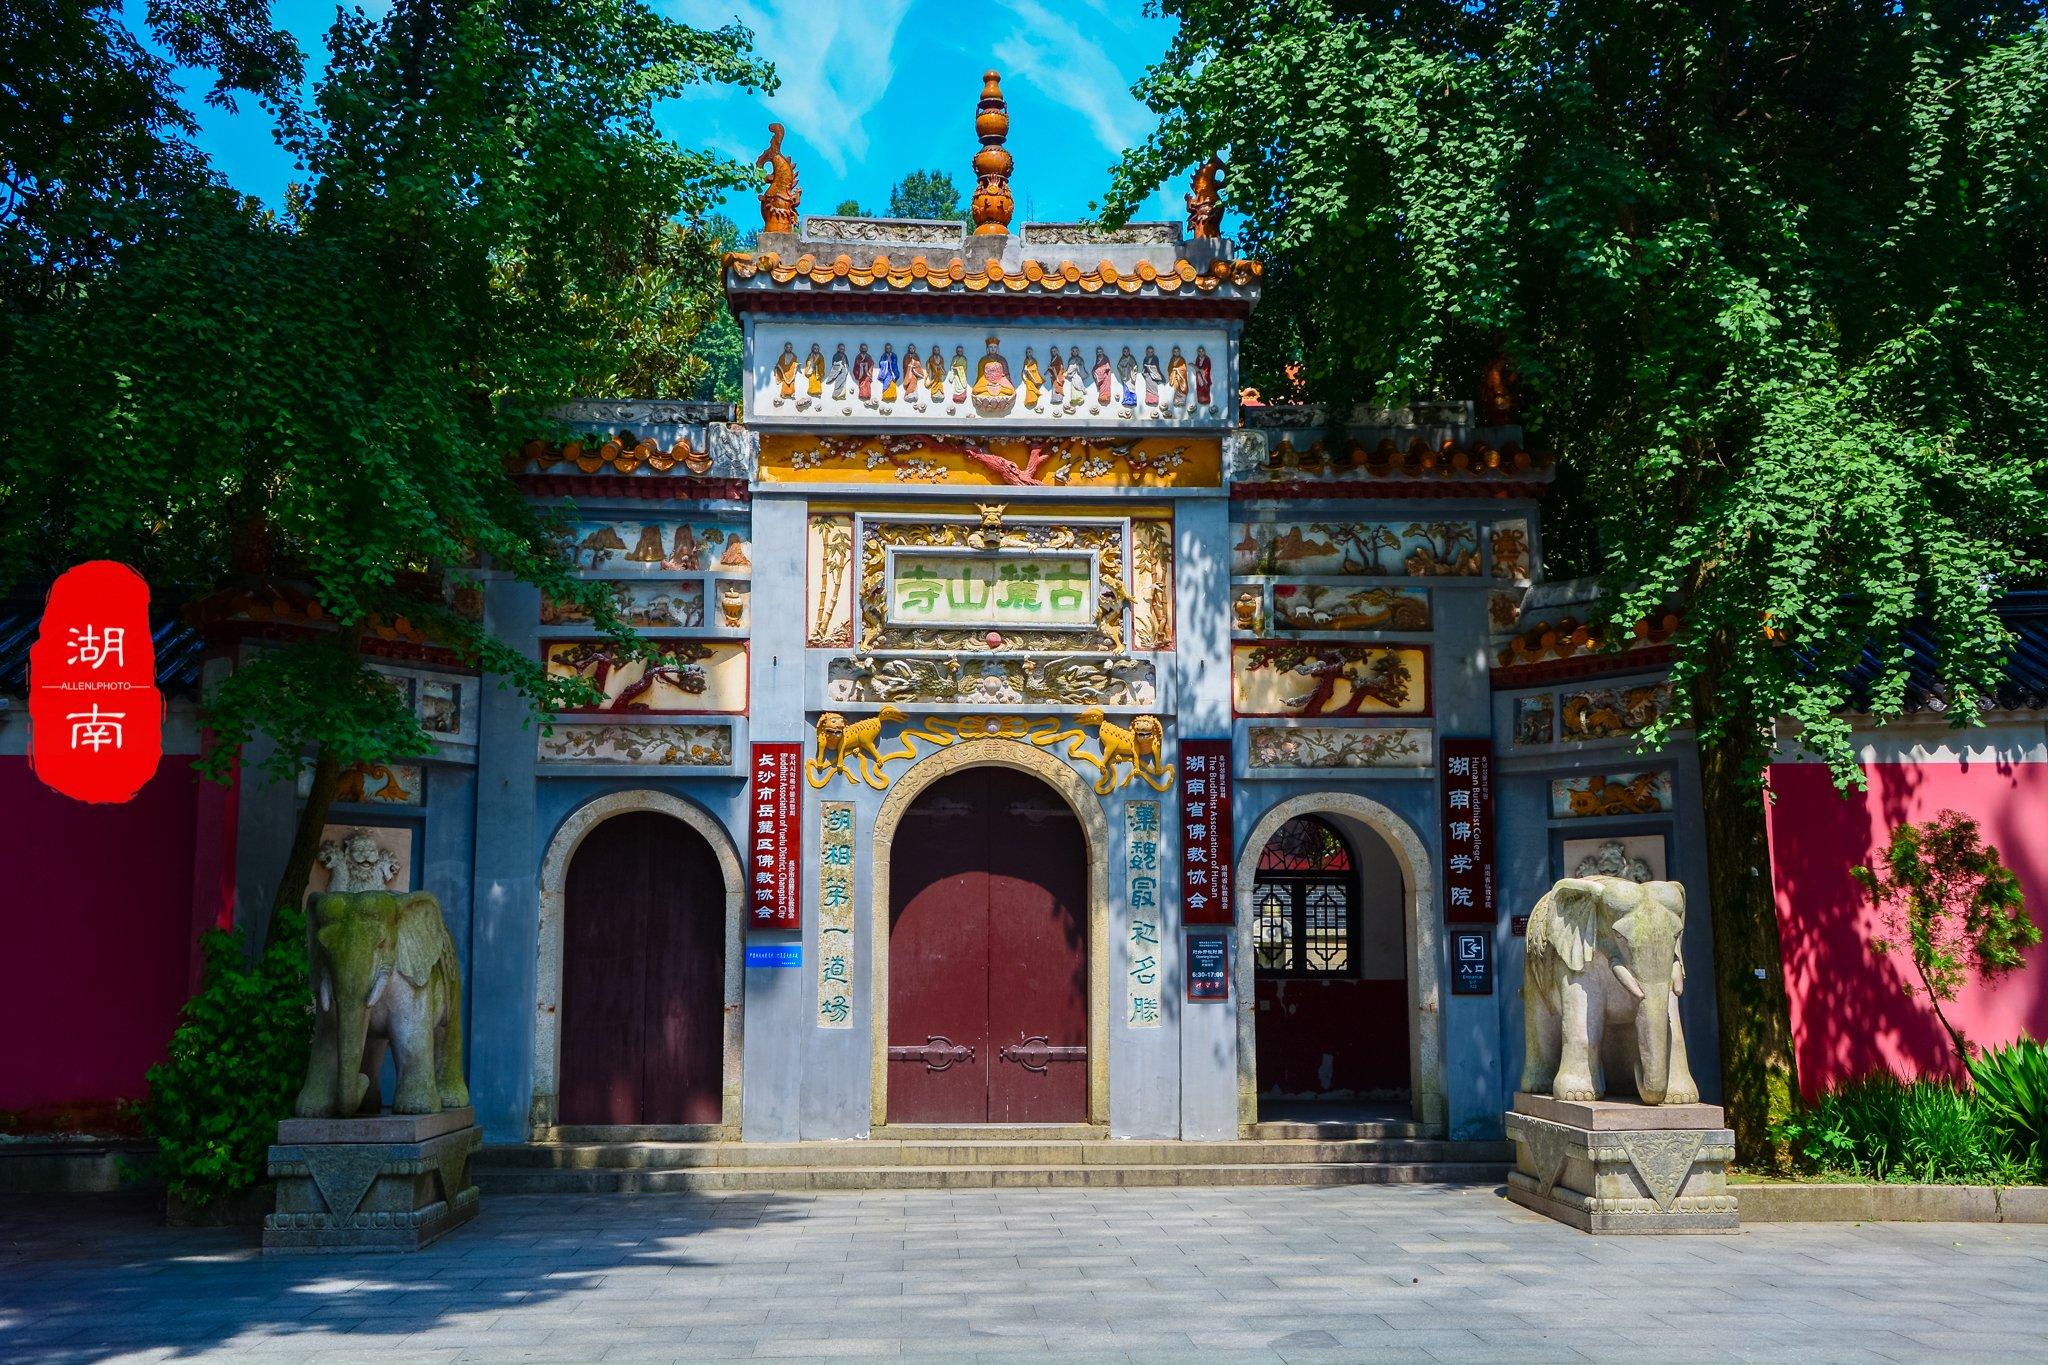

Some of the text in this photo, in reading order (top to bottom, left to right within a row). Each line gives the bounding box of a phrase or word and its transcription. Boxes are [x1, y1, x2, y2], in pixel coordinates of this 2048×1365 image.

[780, 753, 788, 781] Buddhist
[779, 782, 788, 819] Association
[1210, 772, 1218, 810] Buddhist
[1472, 757, 1482, 861] Hunan Buddhist College
[755, 753, 776, 919] 长沙市岳麓区佛教协会
[779, 828, 788, 846] Yuelu
[1186, 755, 1208, 909] 湖南省佛教协会
[1210, 811, 1219, 859] Association
[1448, 757, 1474, 907] 湖南佛学院
[1211, 860, 1219, 869] of
[777, 873, 787, 905] Changsha
[1211, 870, 1219, 898] Hunan
[777, 906, 787, 919] City
[1461, 964, 1484, 974] 入口
